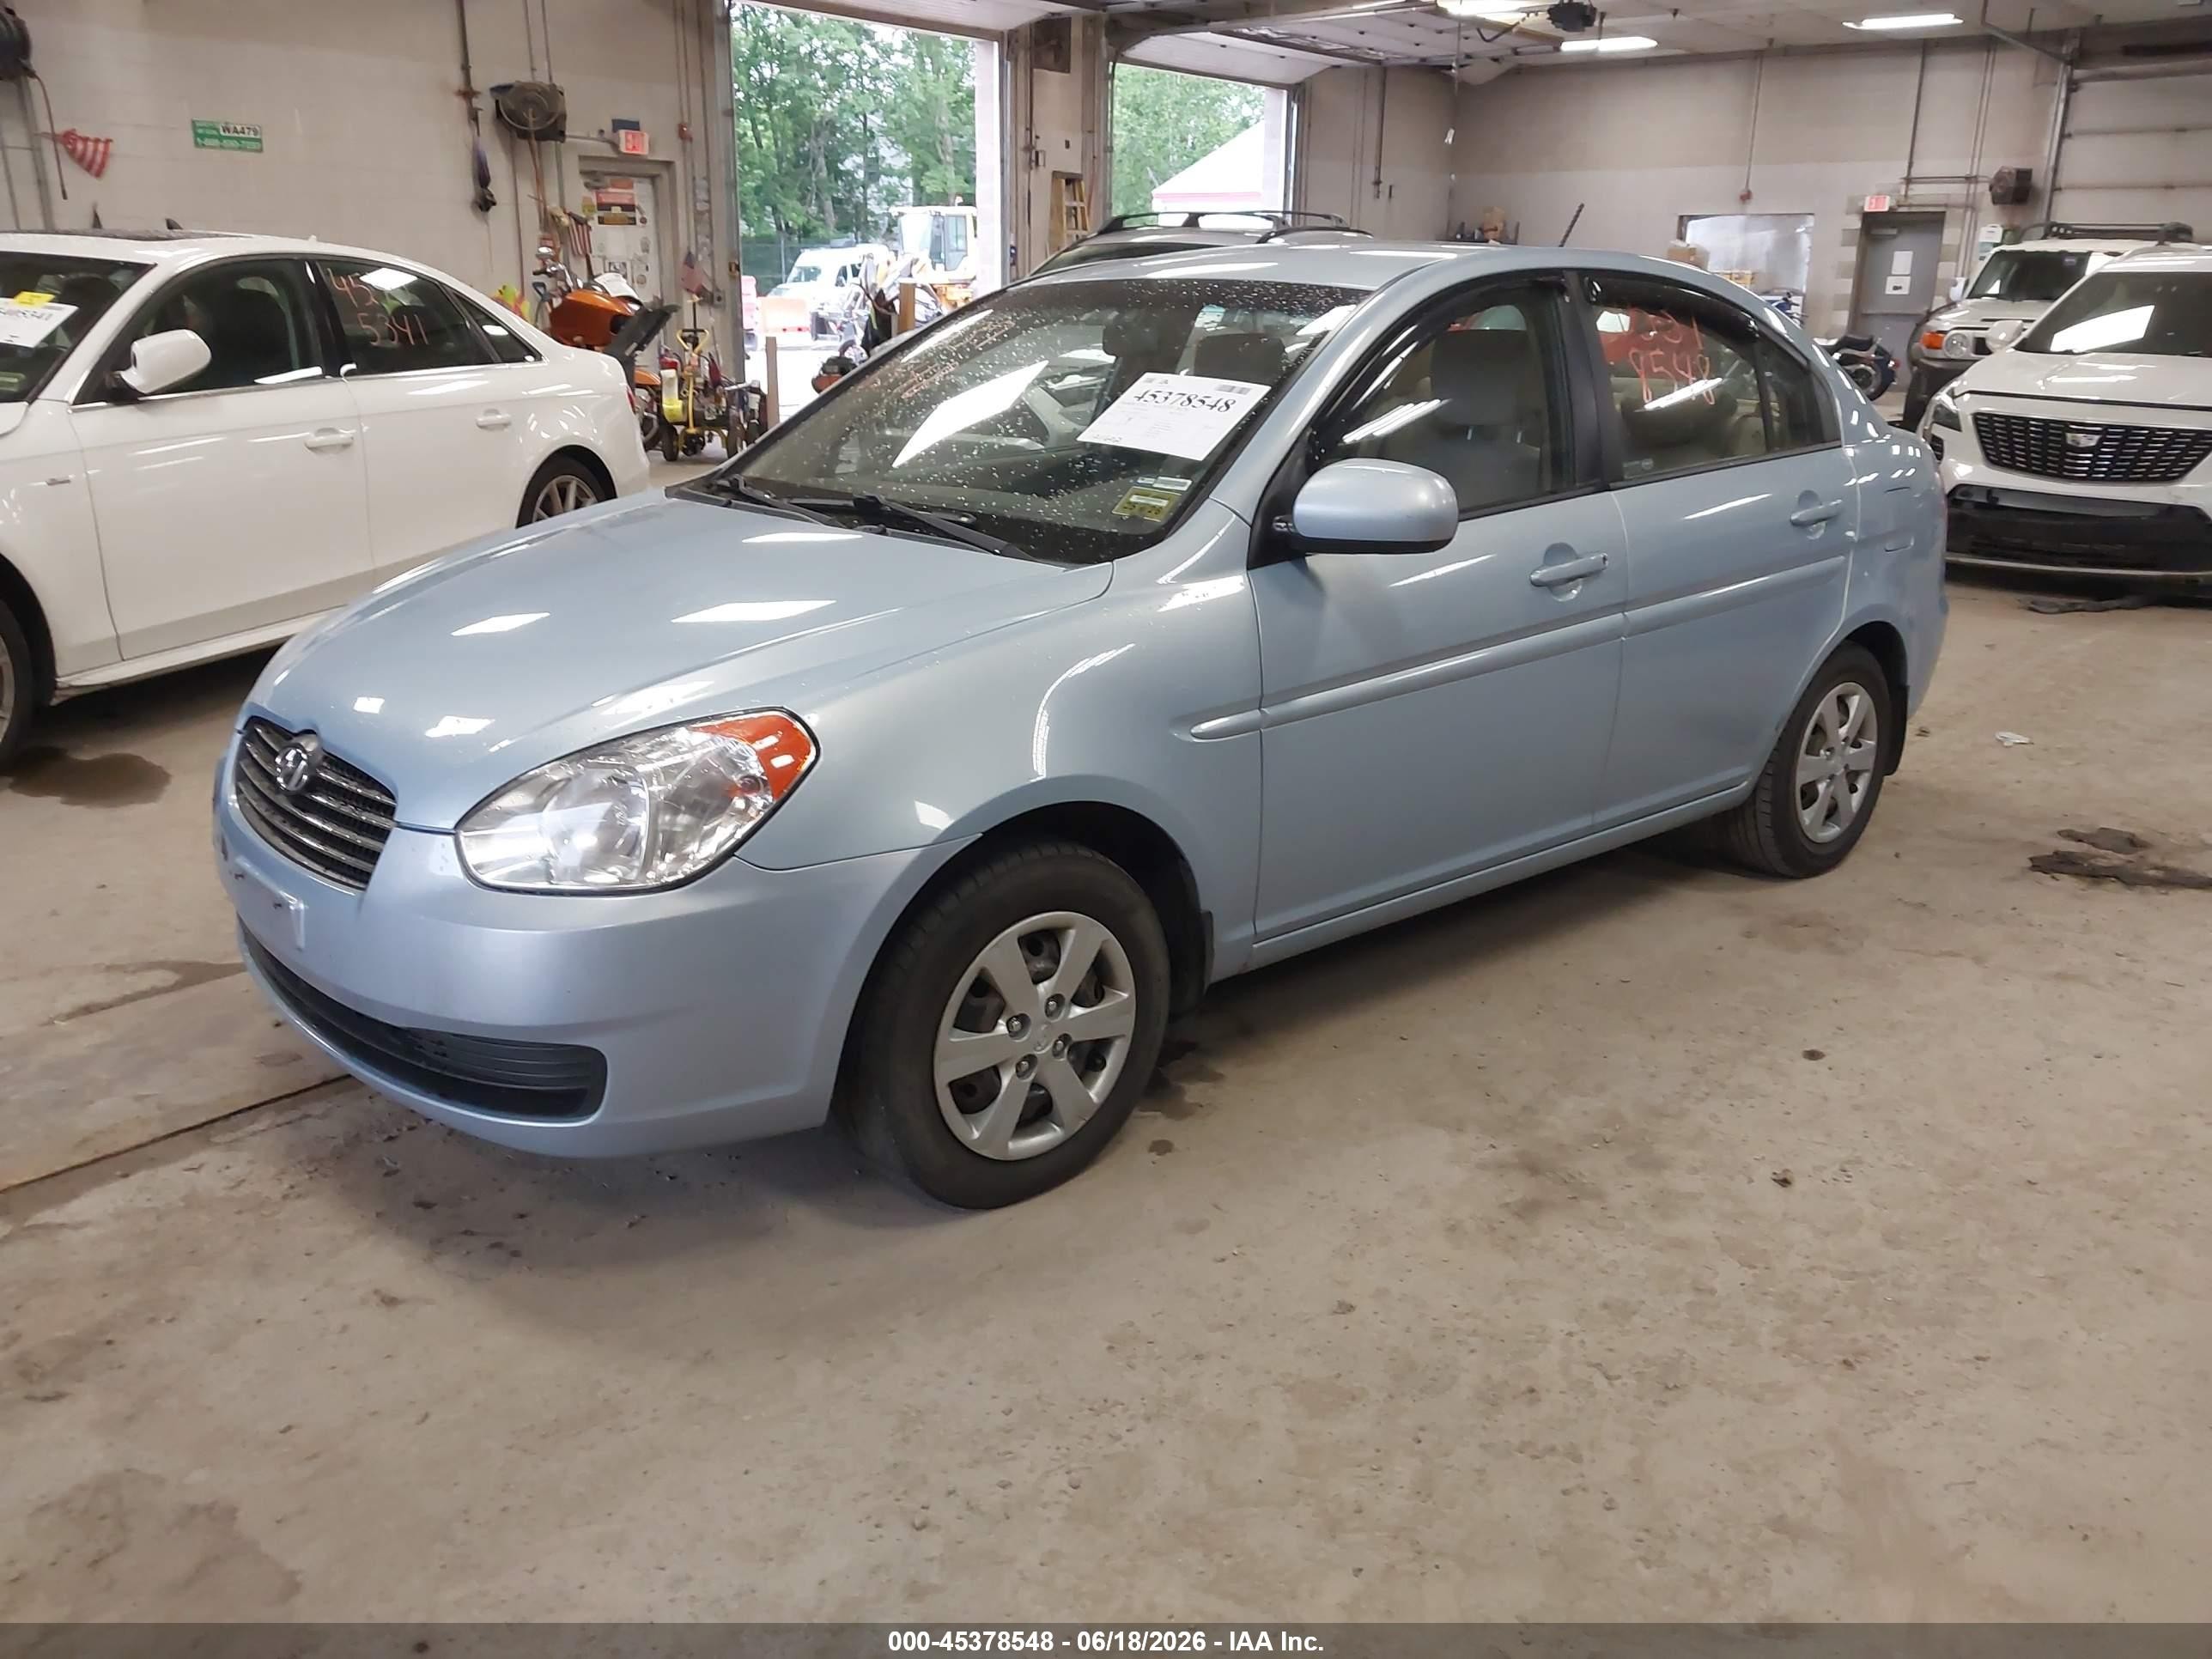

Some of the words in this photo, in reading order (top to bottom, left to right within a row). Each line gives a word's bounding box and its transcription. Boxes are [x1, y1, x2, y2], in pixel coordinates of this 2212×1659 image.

[222, 125, 259, 137] WA479
[327, 268, 379, 309] 45
[357, 313, 429, 348] 5341
[1133, 389, 1237, 413] 45378548
